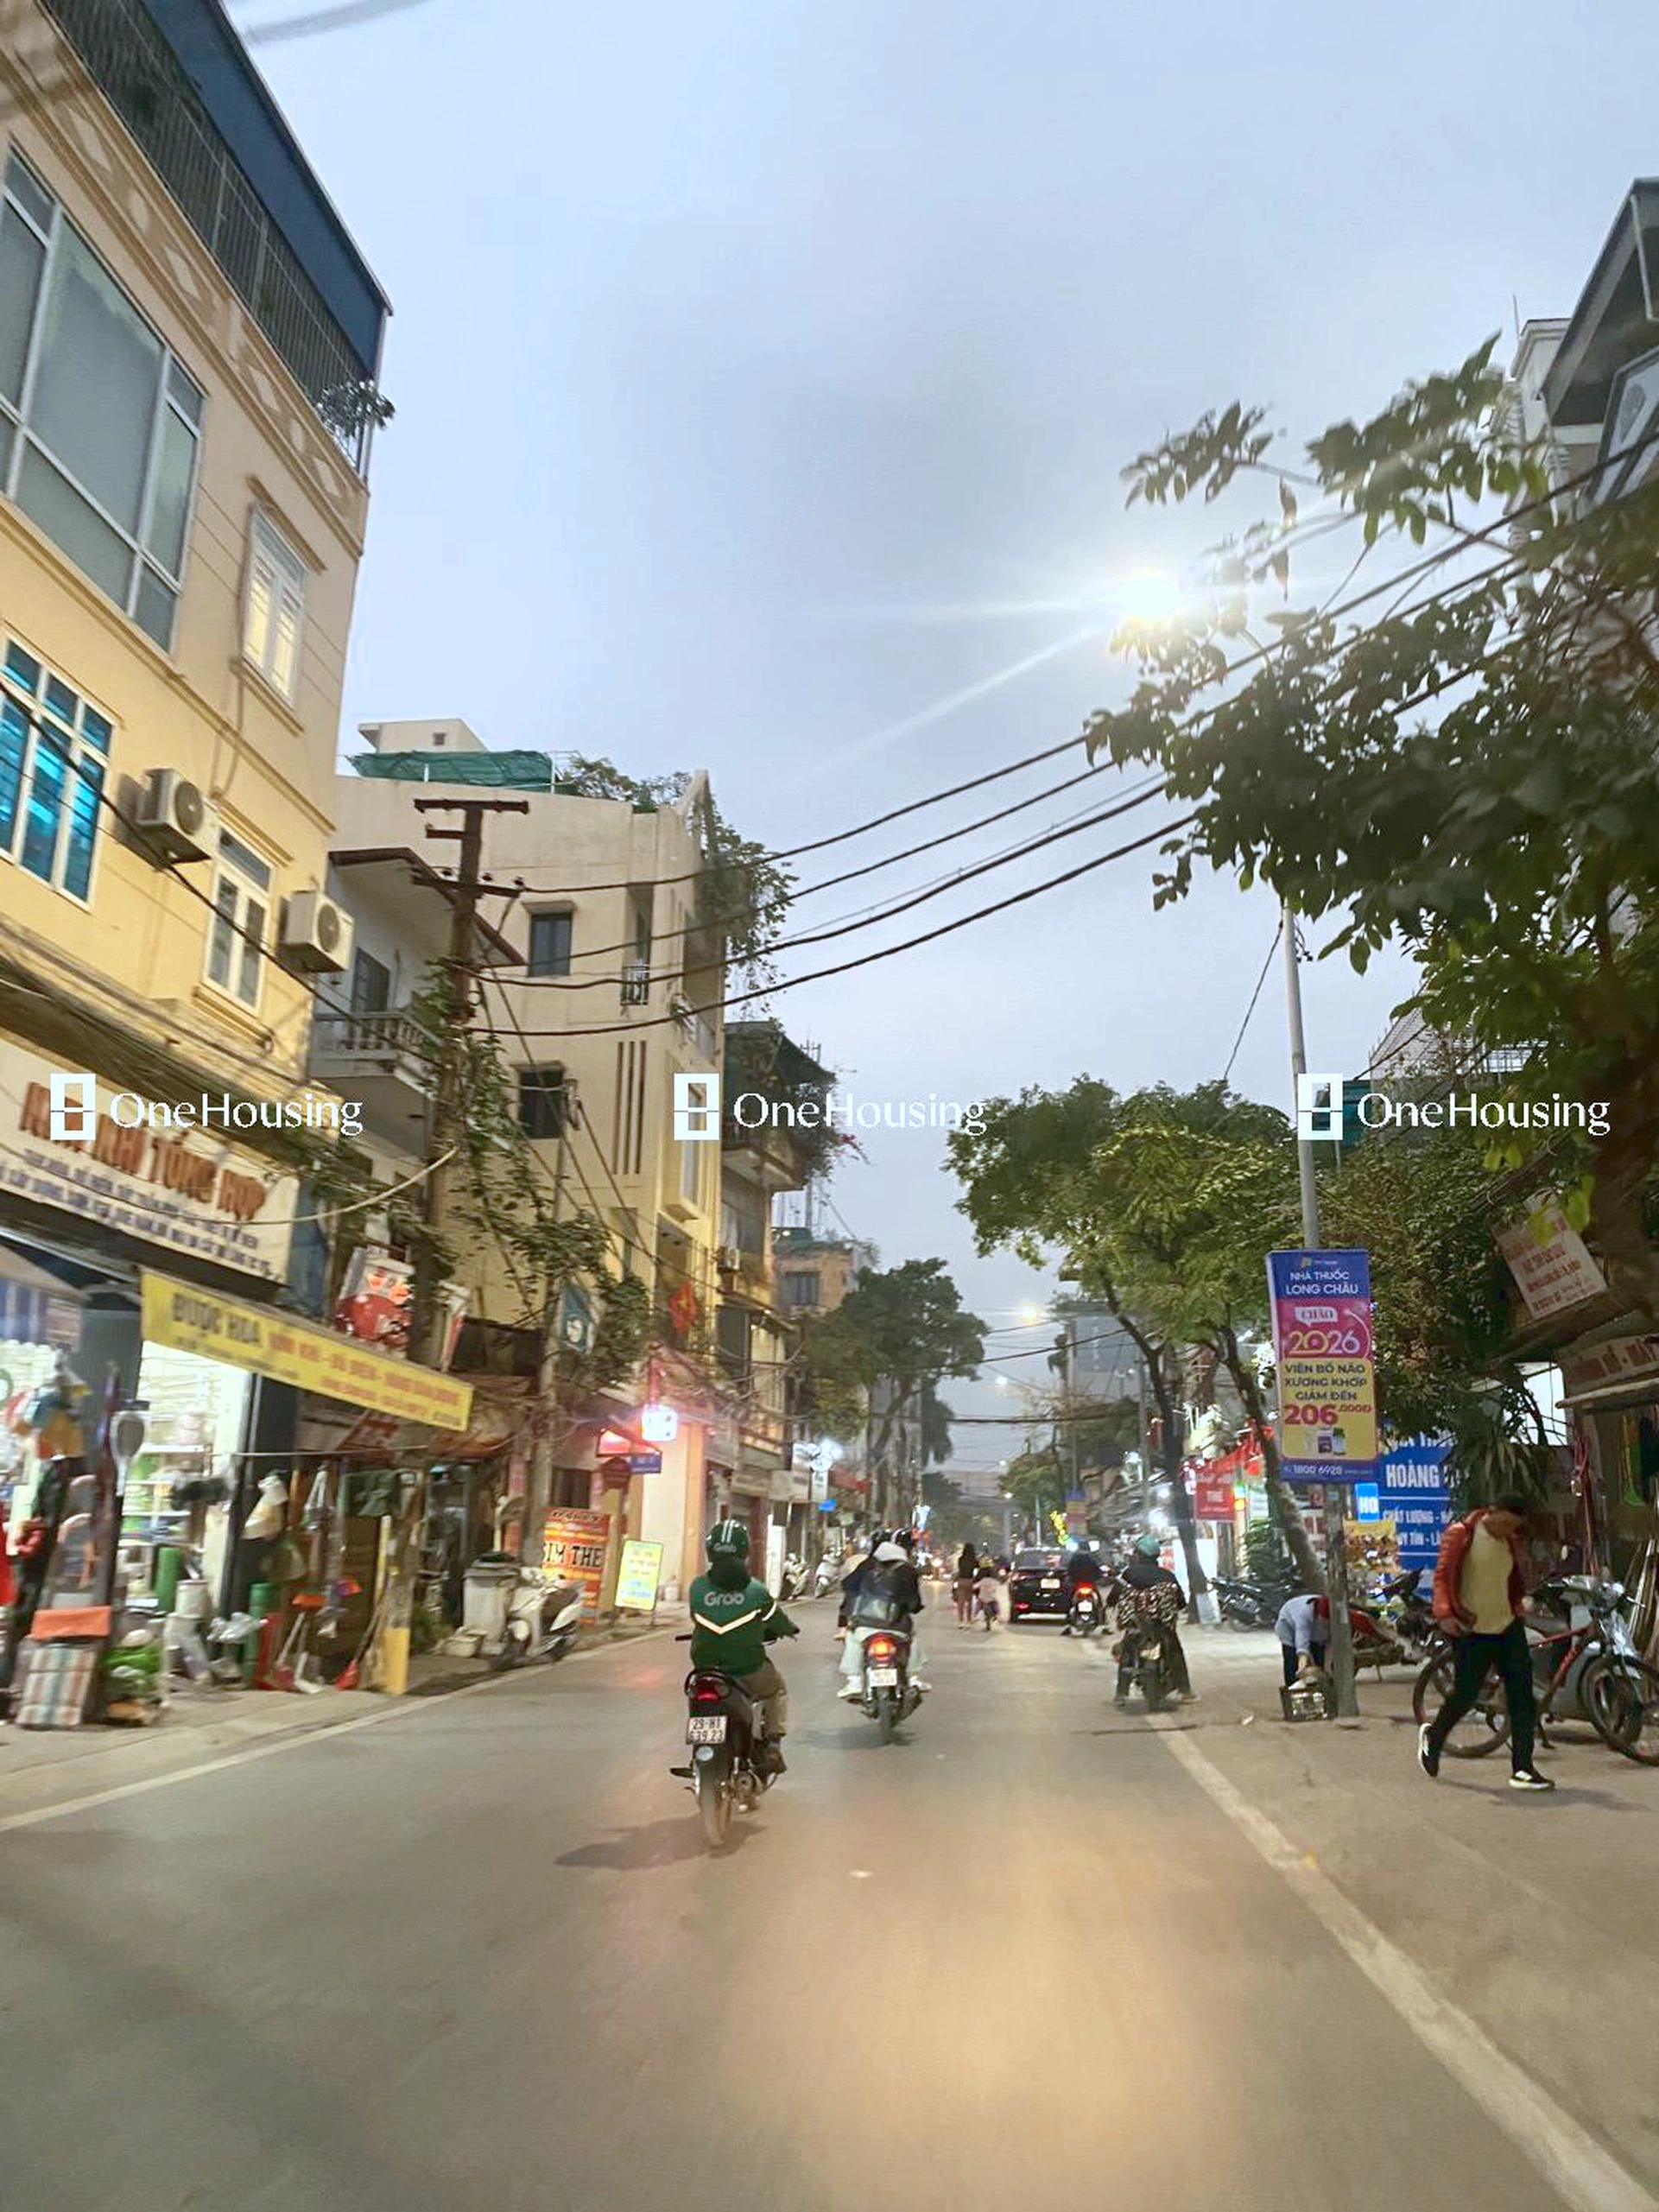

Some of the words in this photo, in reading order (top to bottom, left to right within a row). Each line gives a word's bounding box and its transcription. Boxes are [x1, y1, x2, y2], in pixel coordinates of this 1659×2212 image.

[1314, 1266, 1350, 1280] THUỐC
[1285, 1283, 1321, 1295] LONG
[1323, 1280, 1359, 1295] CHÂU
[1289, 1330, 1361, 1354] 2026
